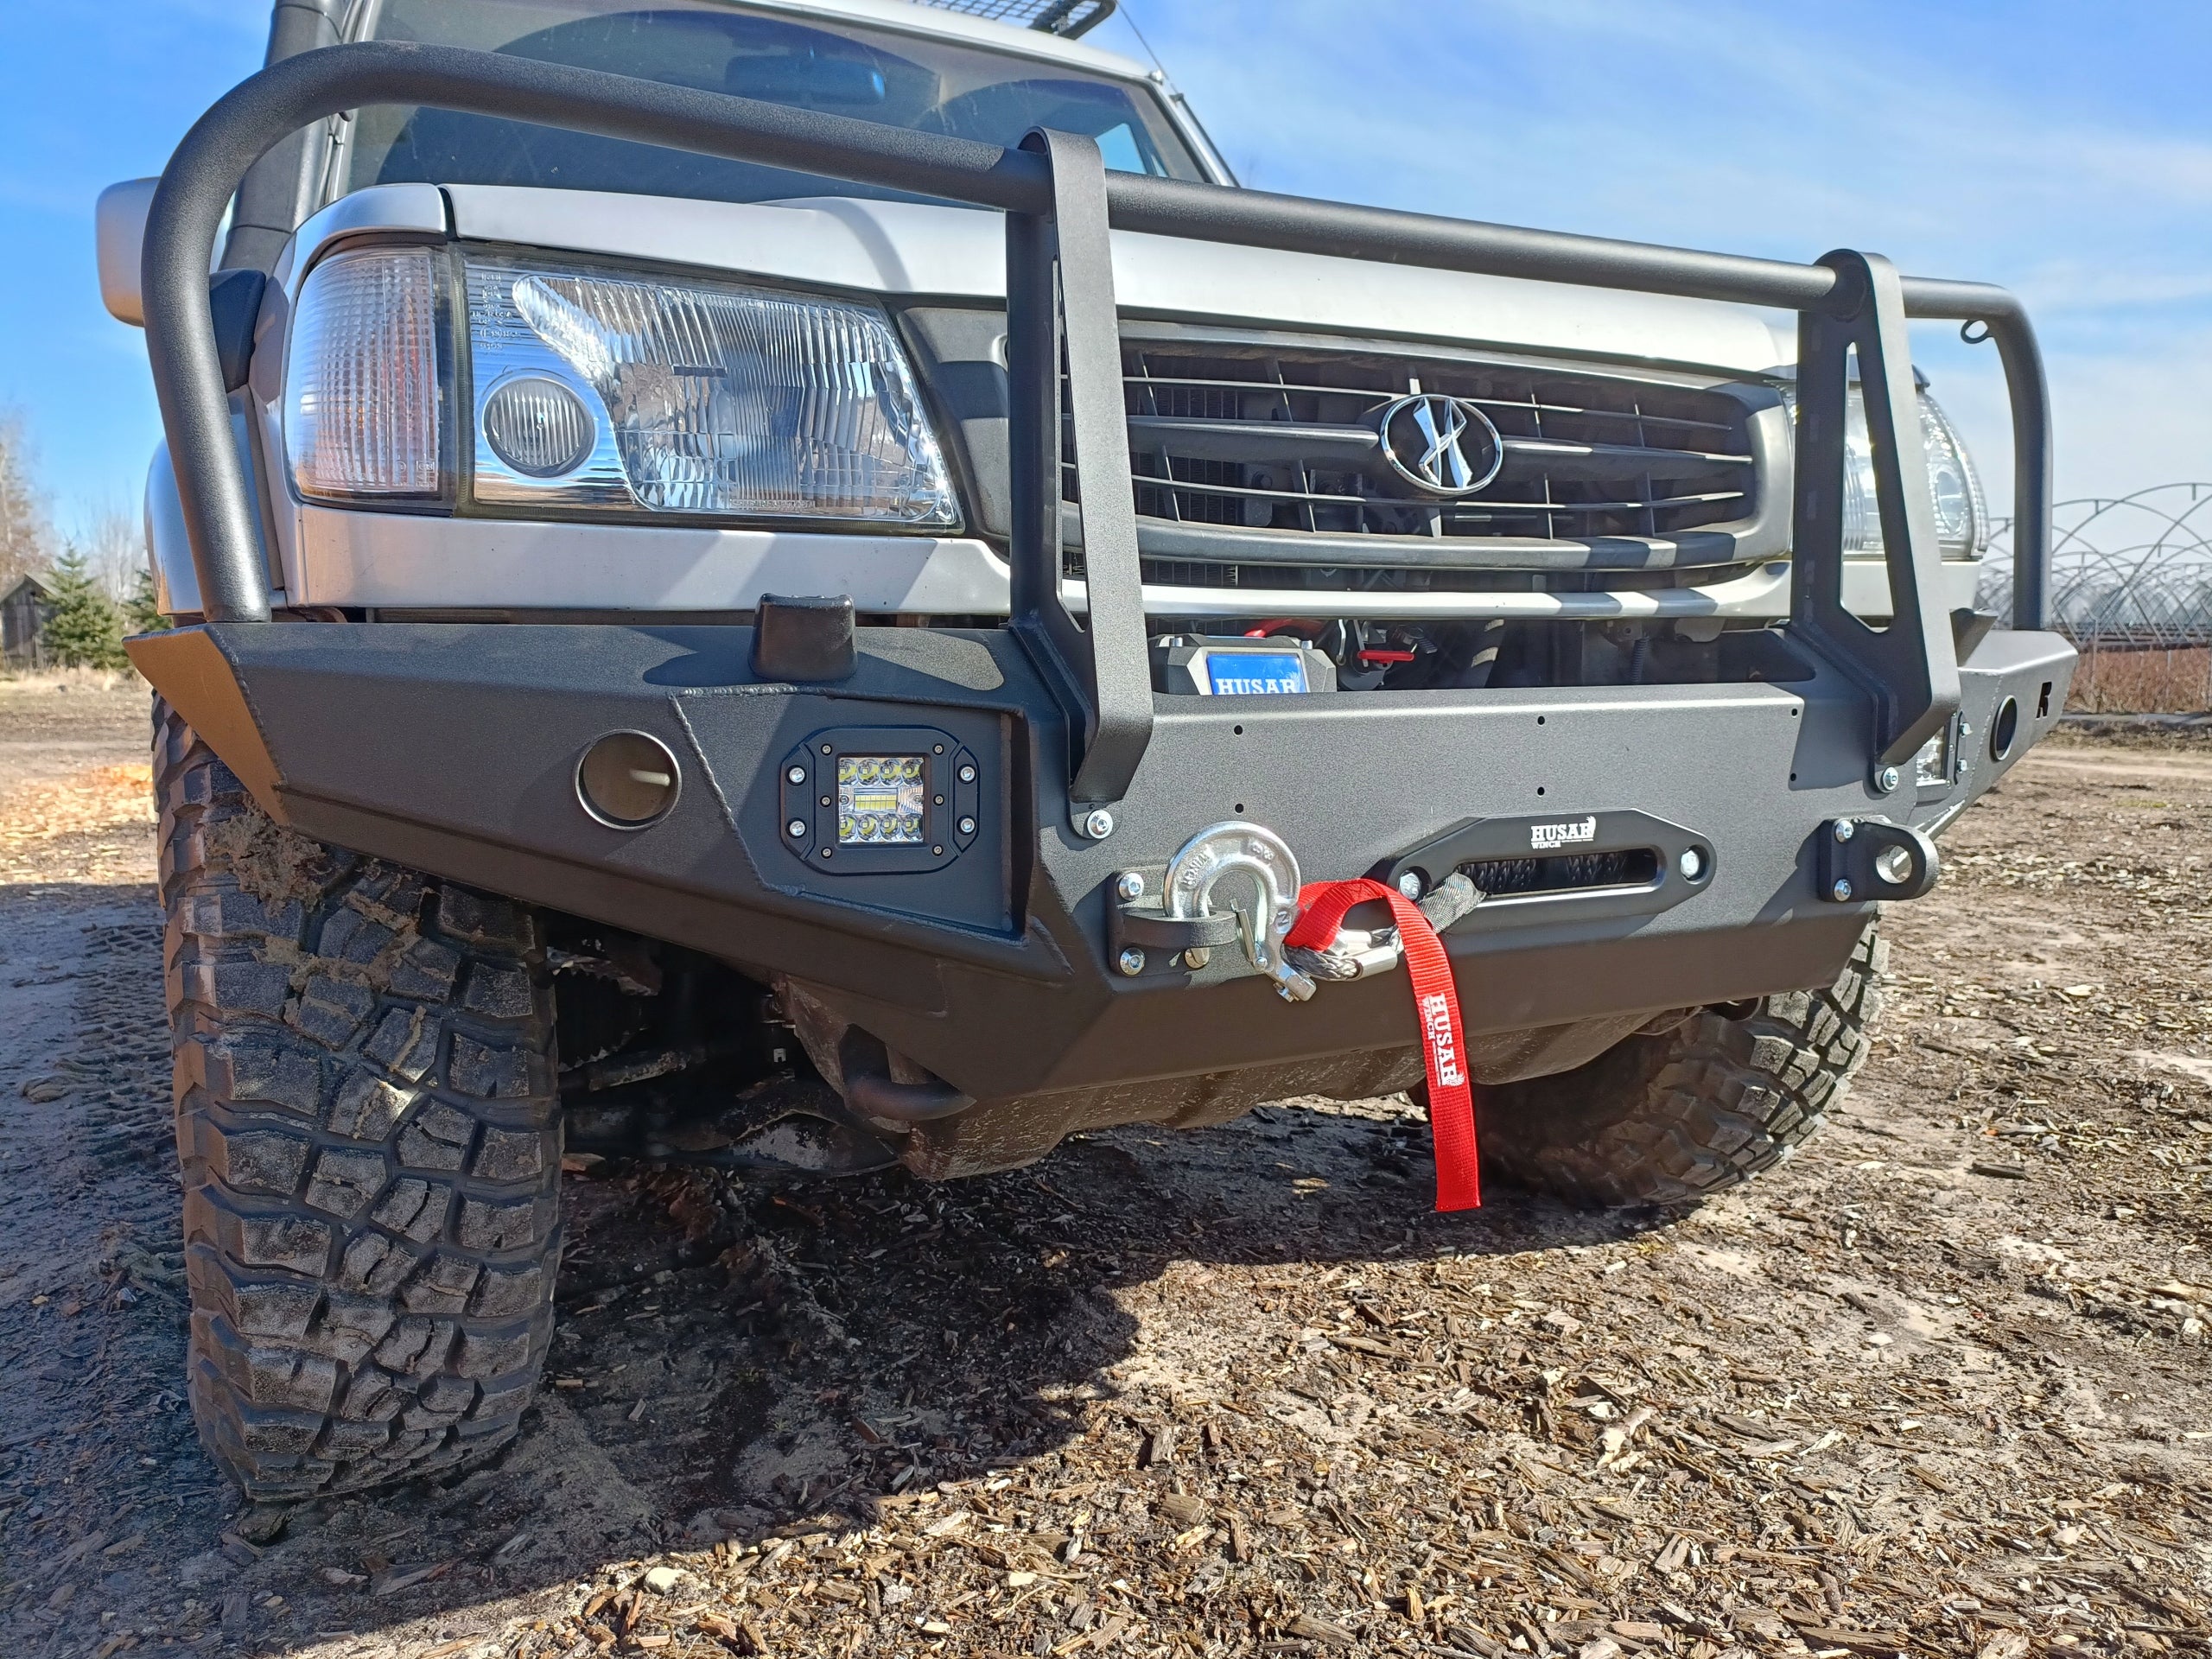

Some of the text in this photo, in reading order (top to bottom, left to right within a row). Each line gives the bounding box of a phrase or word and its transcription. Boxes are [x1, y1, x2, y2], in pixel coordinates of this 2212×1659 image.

[1215, 678, 1299, 695] HUSAR
[1530, 822, 1595, 842] HUSAR
[1421, 995, 1436, 1040] WINCH
[1428, 993, 1459, 1086] HUSAR
